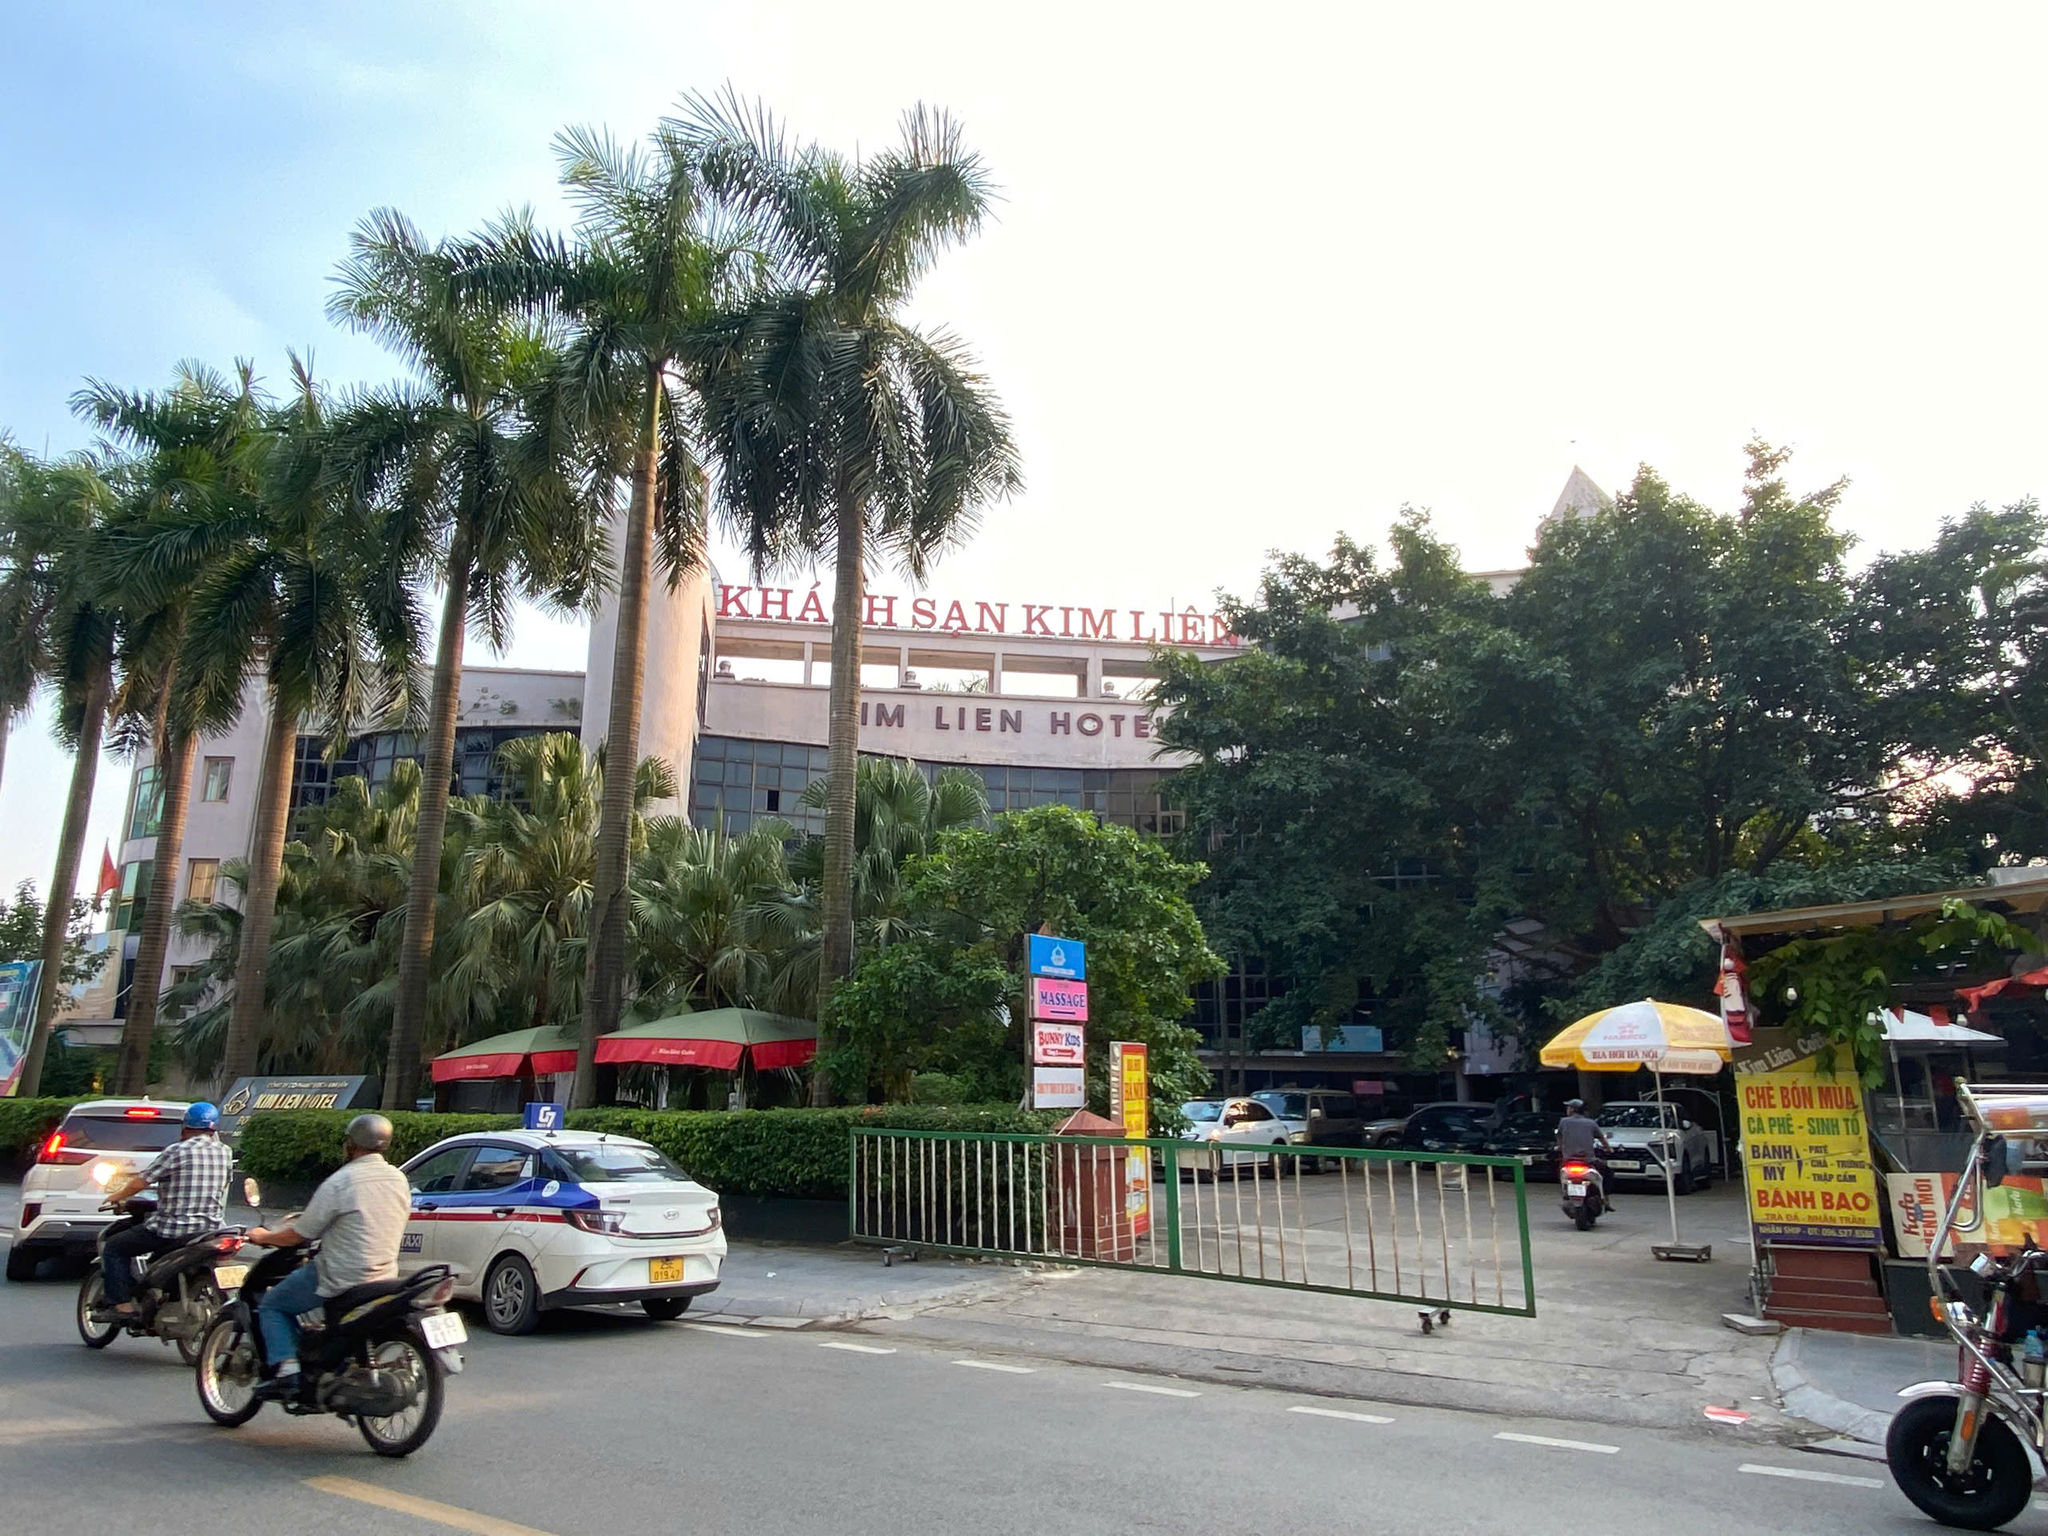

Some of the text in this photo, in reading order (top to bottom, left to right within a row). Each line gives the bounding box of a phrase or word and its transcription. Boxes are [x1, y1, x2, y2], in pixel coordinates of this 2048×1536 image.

[717, 581, 898, 626] KHÁH
[911, 598, 1008, 638] SẠN
[1022, 604, 1117, 640] KIM
[861, 702, 905, 728] IM
[935, 706, 1023, 734] LIEN
[1040, 992, 1086, 1008] MASSAGE
[1038, 1031, 1064, 1046] BUNNY
[1764, 1046, 1796, 1068] Liên
[301, 1093, 338, 1109] HOTEL
[1745, 1077, 1856, 1110] CHÈ BỐN MÙA
[539, 1106, 557, 1129] G7
[1747, 1113, 1765, 1135] CÀ
[1768, 1113, 1795, 1135] PHÊ
[1807, 1117, 1840, 1135] SINH
[1751, 1142, 1793, 1159] BÁNH
[1756, 1188, 1871, 1212] BÁNH BAO
[1898, 1193, 1920, 1236] Kafa
